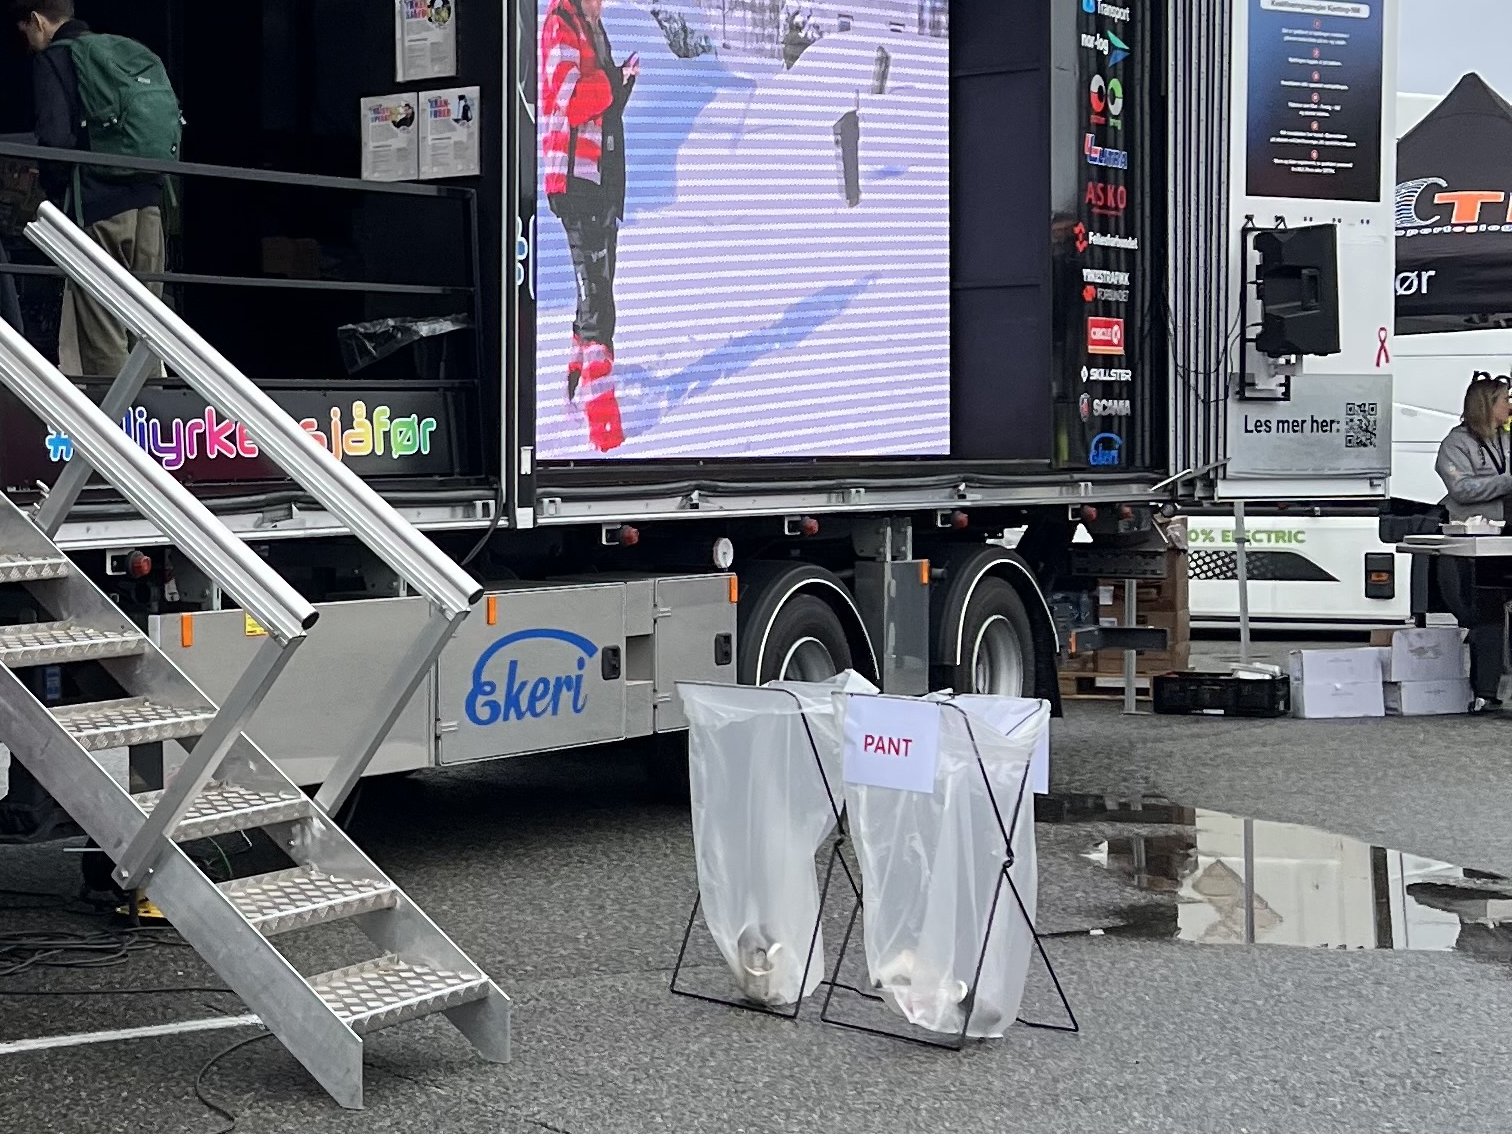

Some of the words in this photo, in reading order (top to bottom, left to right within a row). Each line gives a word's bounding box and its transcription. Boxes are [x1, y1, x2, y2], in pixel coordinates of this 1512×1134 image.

[1085, 180, 1127, 210] ASKO
[1089, 368, 1132, 381] SKILLSTER
[1092, 398, 1131, 417] SCANIA
[1244, 415, 1273, 434] Les
[1276, 418, 1307, 434] mer
[1310, 415, 1341, 434] her:
[1221, 529, 1307, 544] ECTRIC
[464, 628, 599, 726] Ekeri
[863, 734, 913, 758] PANT
